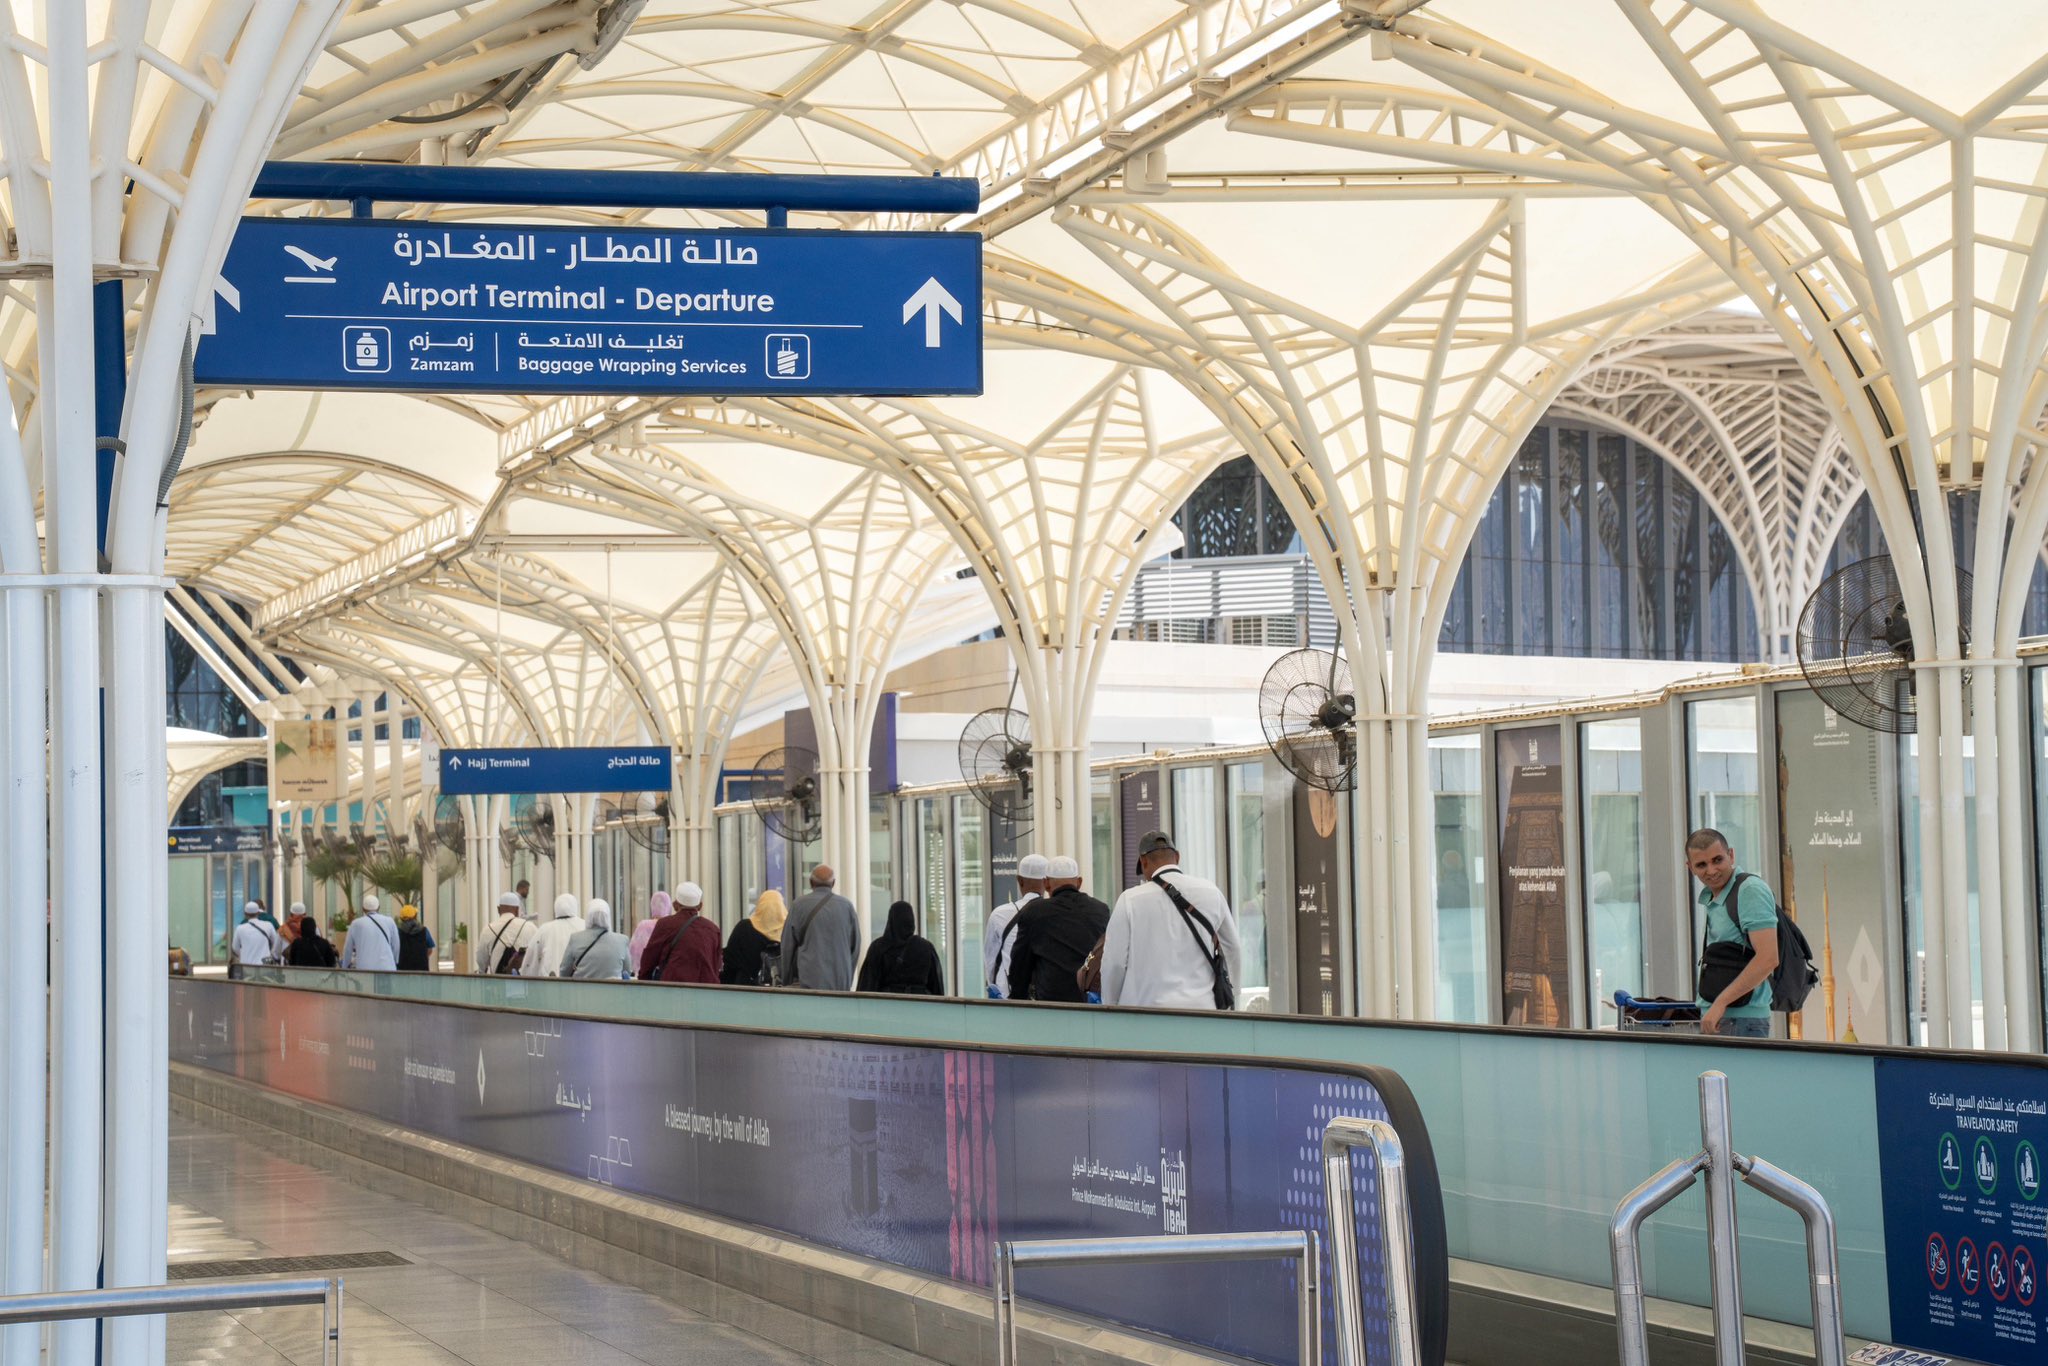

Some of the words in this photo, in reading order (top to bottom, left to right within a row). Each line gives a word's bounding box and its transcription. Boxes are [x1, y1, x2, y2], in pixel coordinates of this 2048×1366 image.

[394, 233, 535, 266] المغادرة
[565, 236, 671, 270] المطار
[682, 239, 758, 265] صالة
[381, 281, 478, 311] Airport
[485, 284, 606, 309] Terminal
[636, 287, 775, 316] Departure
[409, 331, 474, 352] زمزم
[518, 332, 603, 349] الامتعة
[608, 334, 684, 353] تغليف
[410, 357, 474, 372] Zamzam
[518, 357, 594, 374] Baggage
[599, 358, 677, 375] Wrapping
[681, 359, 747, 374] Services
[467, 758, 488, 770] Hajj
[489, 757, 530, 768] Terminal
[608, 757, 637, 769] الحجاج
[639, 756, 661, 766] صالة
[1509, 867, 1529, 878] Perjalanan
[1529, 868, 1539, 879] yang
[1539, 867, 1551, 878] penuh
[1551, 866, 1566, 877] berkah
[1519, 882, 1527, 892] atas
[1527, 881, 1546, 892] kehendak
[1546, 881, 1557, 892] Allah
[1929, 1092, 1955, 1109] المتحركة
[1955, 1095, 1976, 1111] السيور
[1977, 1096, 2004, 1113] استخدام
[2004, 1099, 2015, 1112] عند
[2016, 1099, 2047, 1117] لسلامتكم
[665, 1104, 670, 1127] A
[670, 1104, 691, 1131] blessed
[714, 1112, 722, 1143] by
[723, 1113, 733, 1140] the
[734, 1115, 745, 1142] will
[746, 1117, 753, 1143] of
[753, 1118, 770, 1147] Allah
[1956, 1115, 1996, 1131] TRAVELATOR
[1997, 1119, 2018, 1133] SAFETY
[1072, 1155, 1086, 1180] الدولي
[1087, 1159, 1099, 1178] العزيز
[1109, 1169, 1114, 1181] بن
[1115, 1170, 1129, 1180] محمد
[1130, 1162, 1142, 1184] الأمير
[1143, 1166, 1155, 1186] مطار
[1072, 1188, 1083, 1202] Prince
[1084, 1190, 1107, 1206] Mohammed
[1115, 1195, 1133, 1212] Abdulaziz
[1142, 1200, 1156, 1219] Airport
[1162, 1197, 1187, 1235] TIBAH
